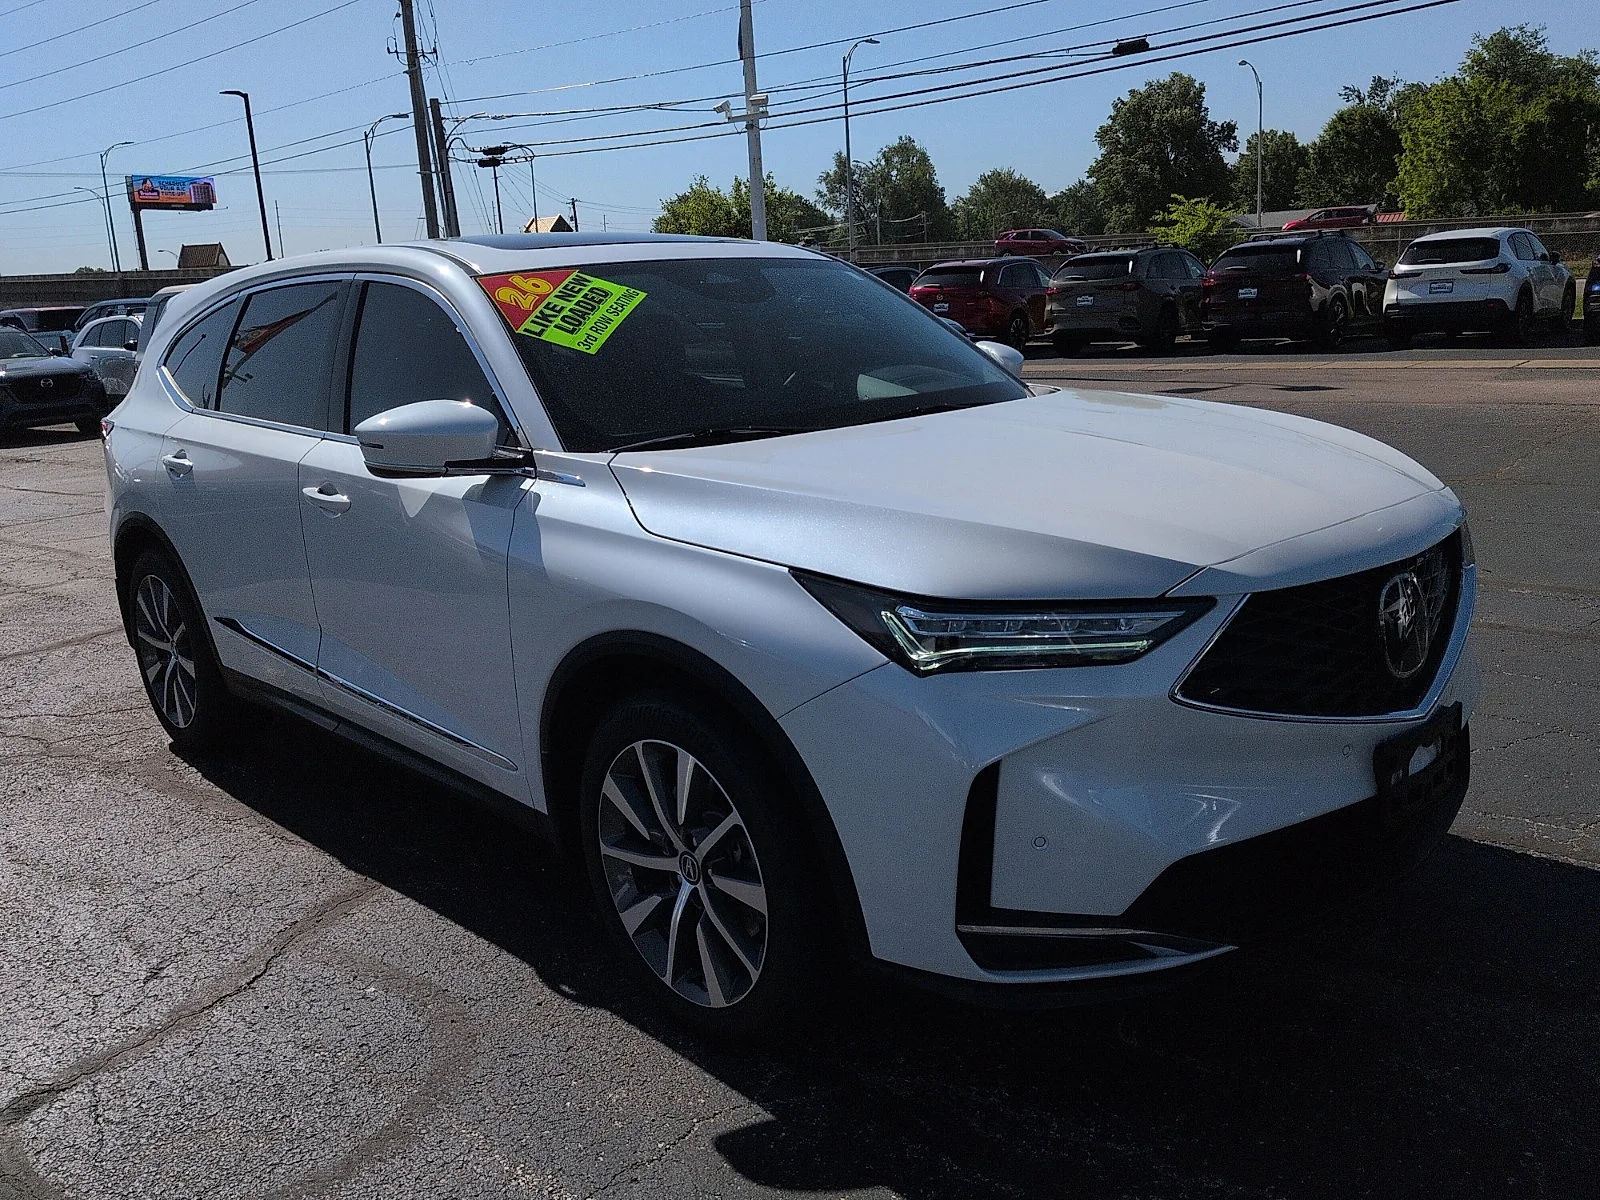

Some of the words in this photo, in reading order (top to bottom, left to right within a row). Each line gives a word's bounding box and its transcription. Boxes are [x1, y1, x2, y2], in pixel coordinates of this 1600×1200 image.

[495, 275, 554, 310] 26
[523, 302, 565, 337] LIKE
[554, 272, 592, 304] NEW
[553, 286, 614, 336] LOADED
[576, 334, 599, 350] 3rd
[594, 313, 615, 336] ROW
[607, 287, 640, 317] SEATING
